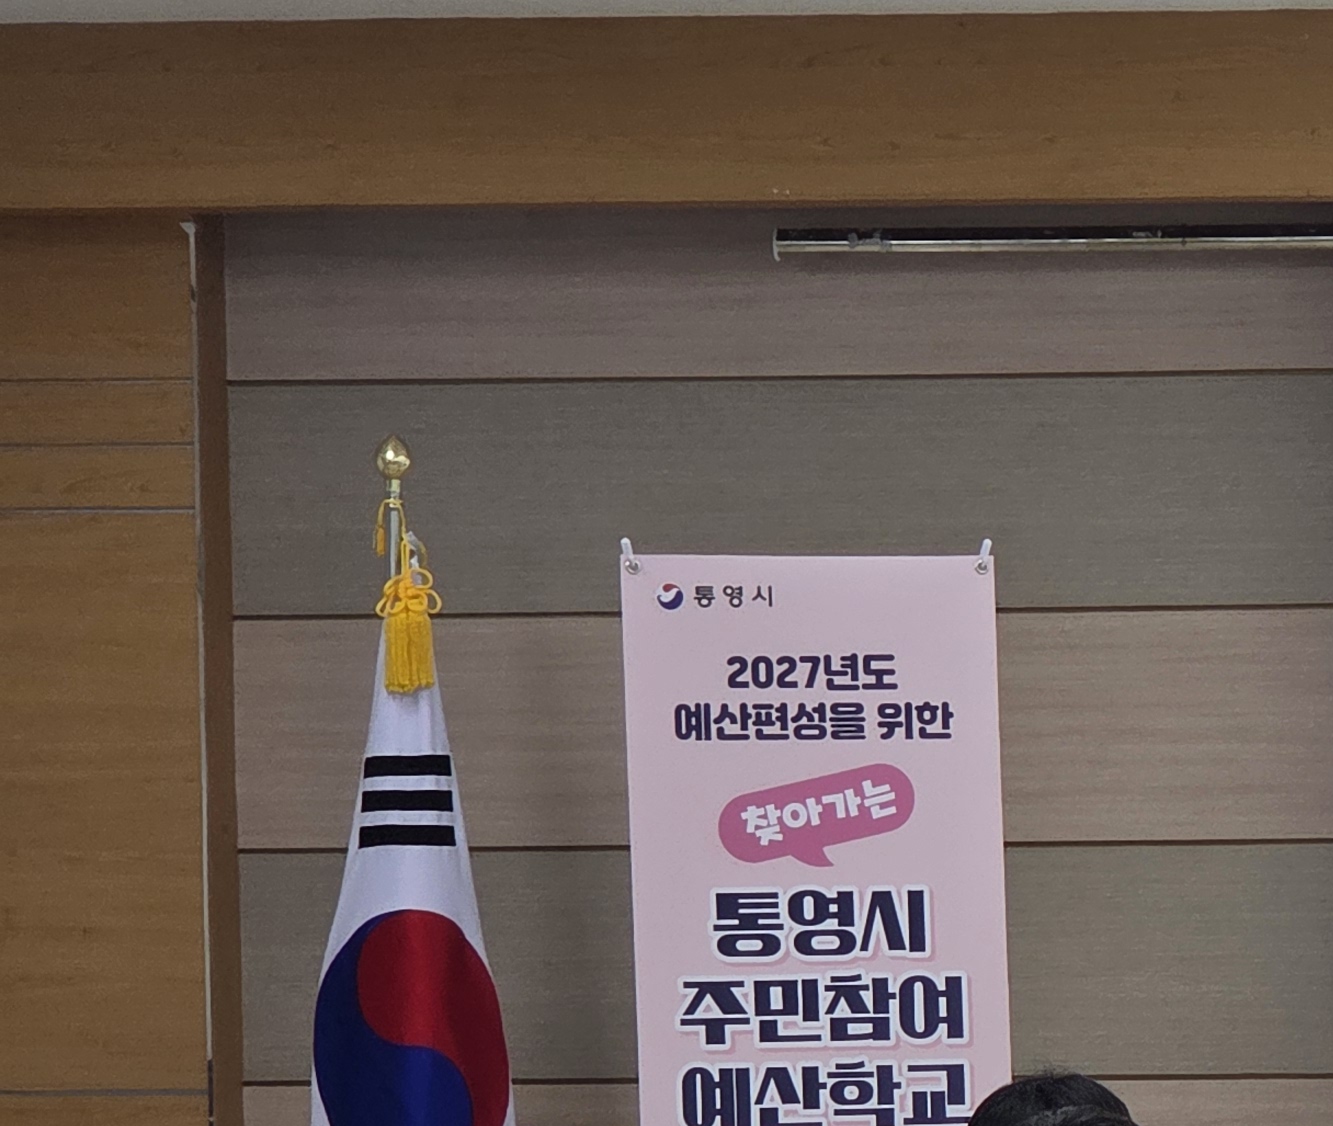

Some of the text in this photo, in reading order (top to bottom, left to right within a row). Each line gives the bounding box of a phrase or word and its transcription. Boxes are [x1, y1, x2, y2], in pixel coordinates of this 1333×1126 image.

[694, 586, 772, 608] 통영시
[727, 653, 898, 690] 2027년도
[675, 702, 954, 741] 예산편성을 위한
[741, 779, 897, 845] 찾아가는
[712, 889, 925, 957] 통영시
[680, 975, 966, 1045] 주민참여
